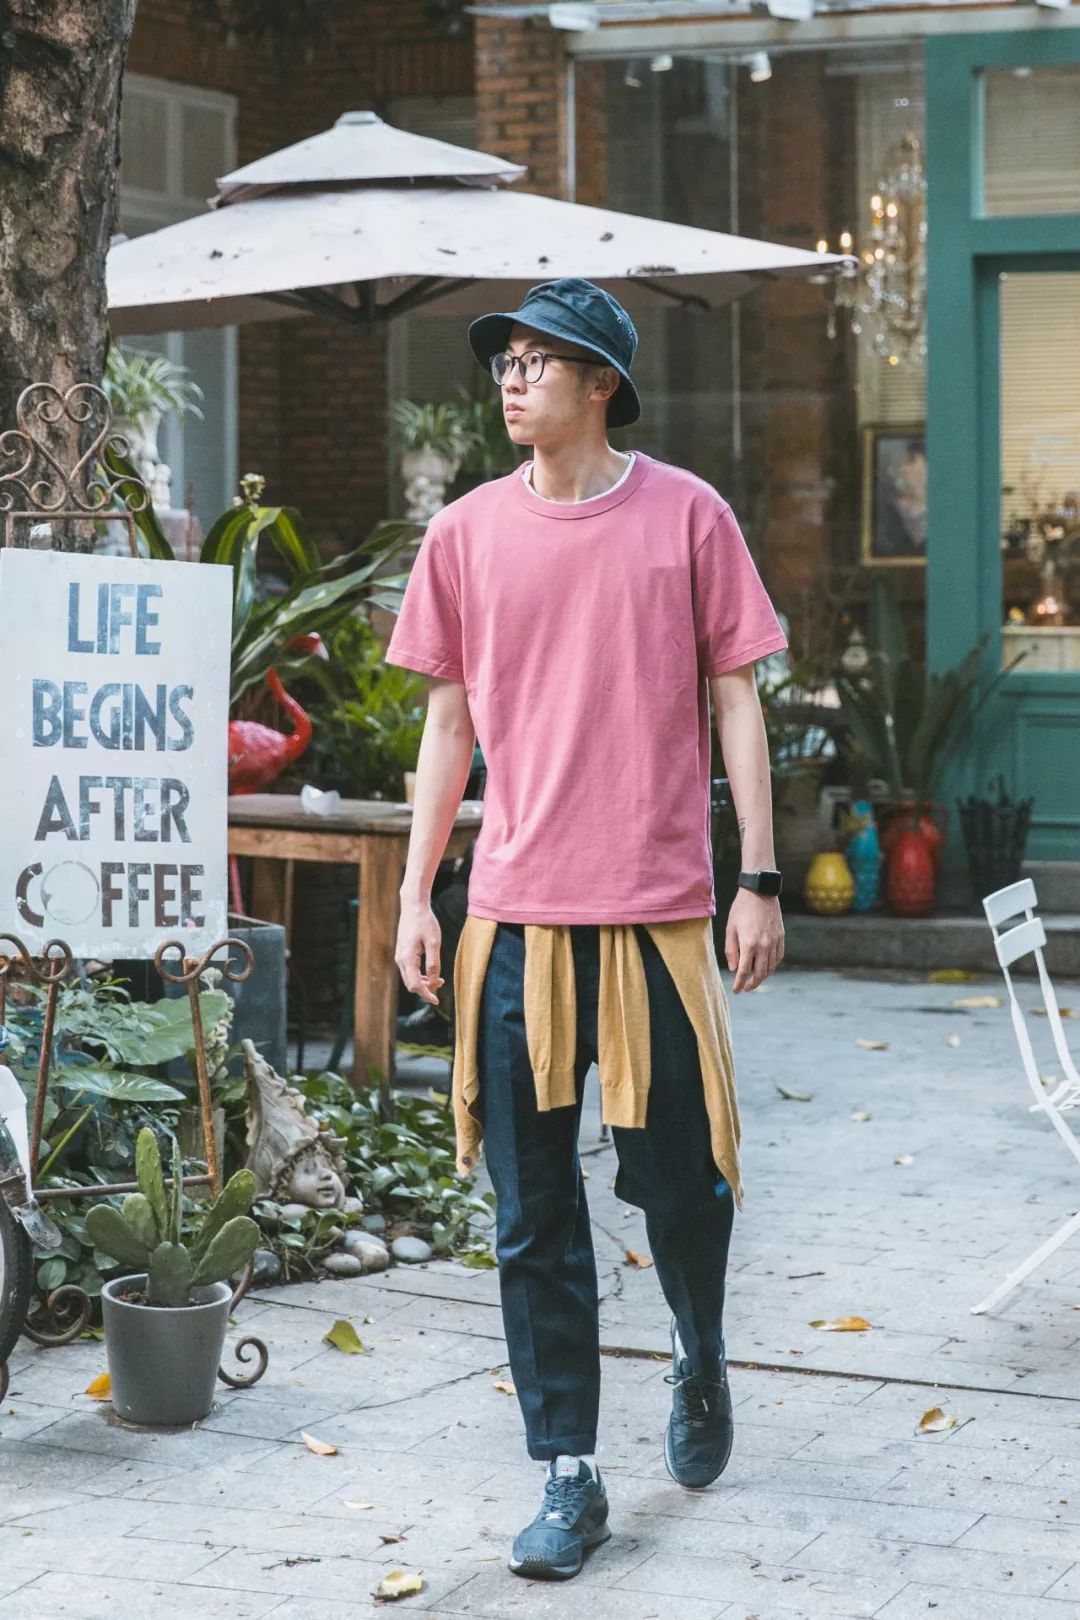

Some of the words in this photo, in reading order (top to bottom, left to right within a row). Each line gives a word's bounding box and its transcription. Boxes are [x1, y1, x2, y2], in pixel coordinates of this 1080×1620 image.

[67, 582, 163, 655] LIFE
[31, 679, 195, 752] BEGINS
[34, 775, 192, 843] AFTER
[16, 860, 206, 928] COFFEE
